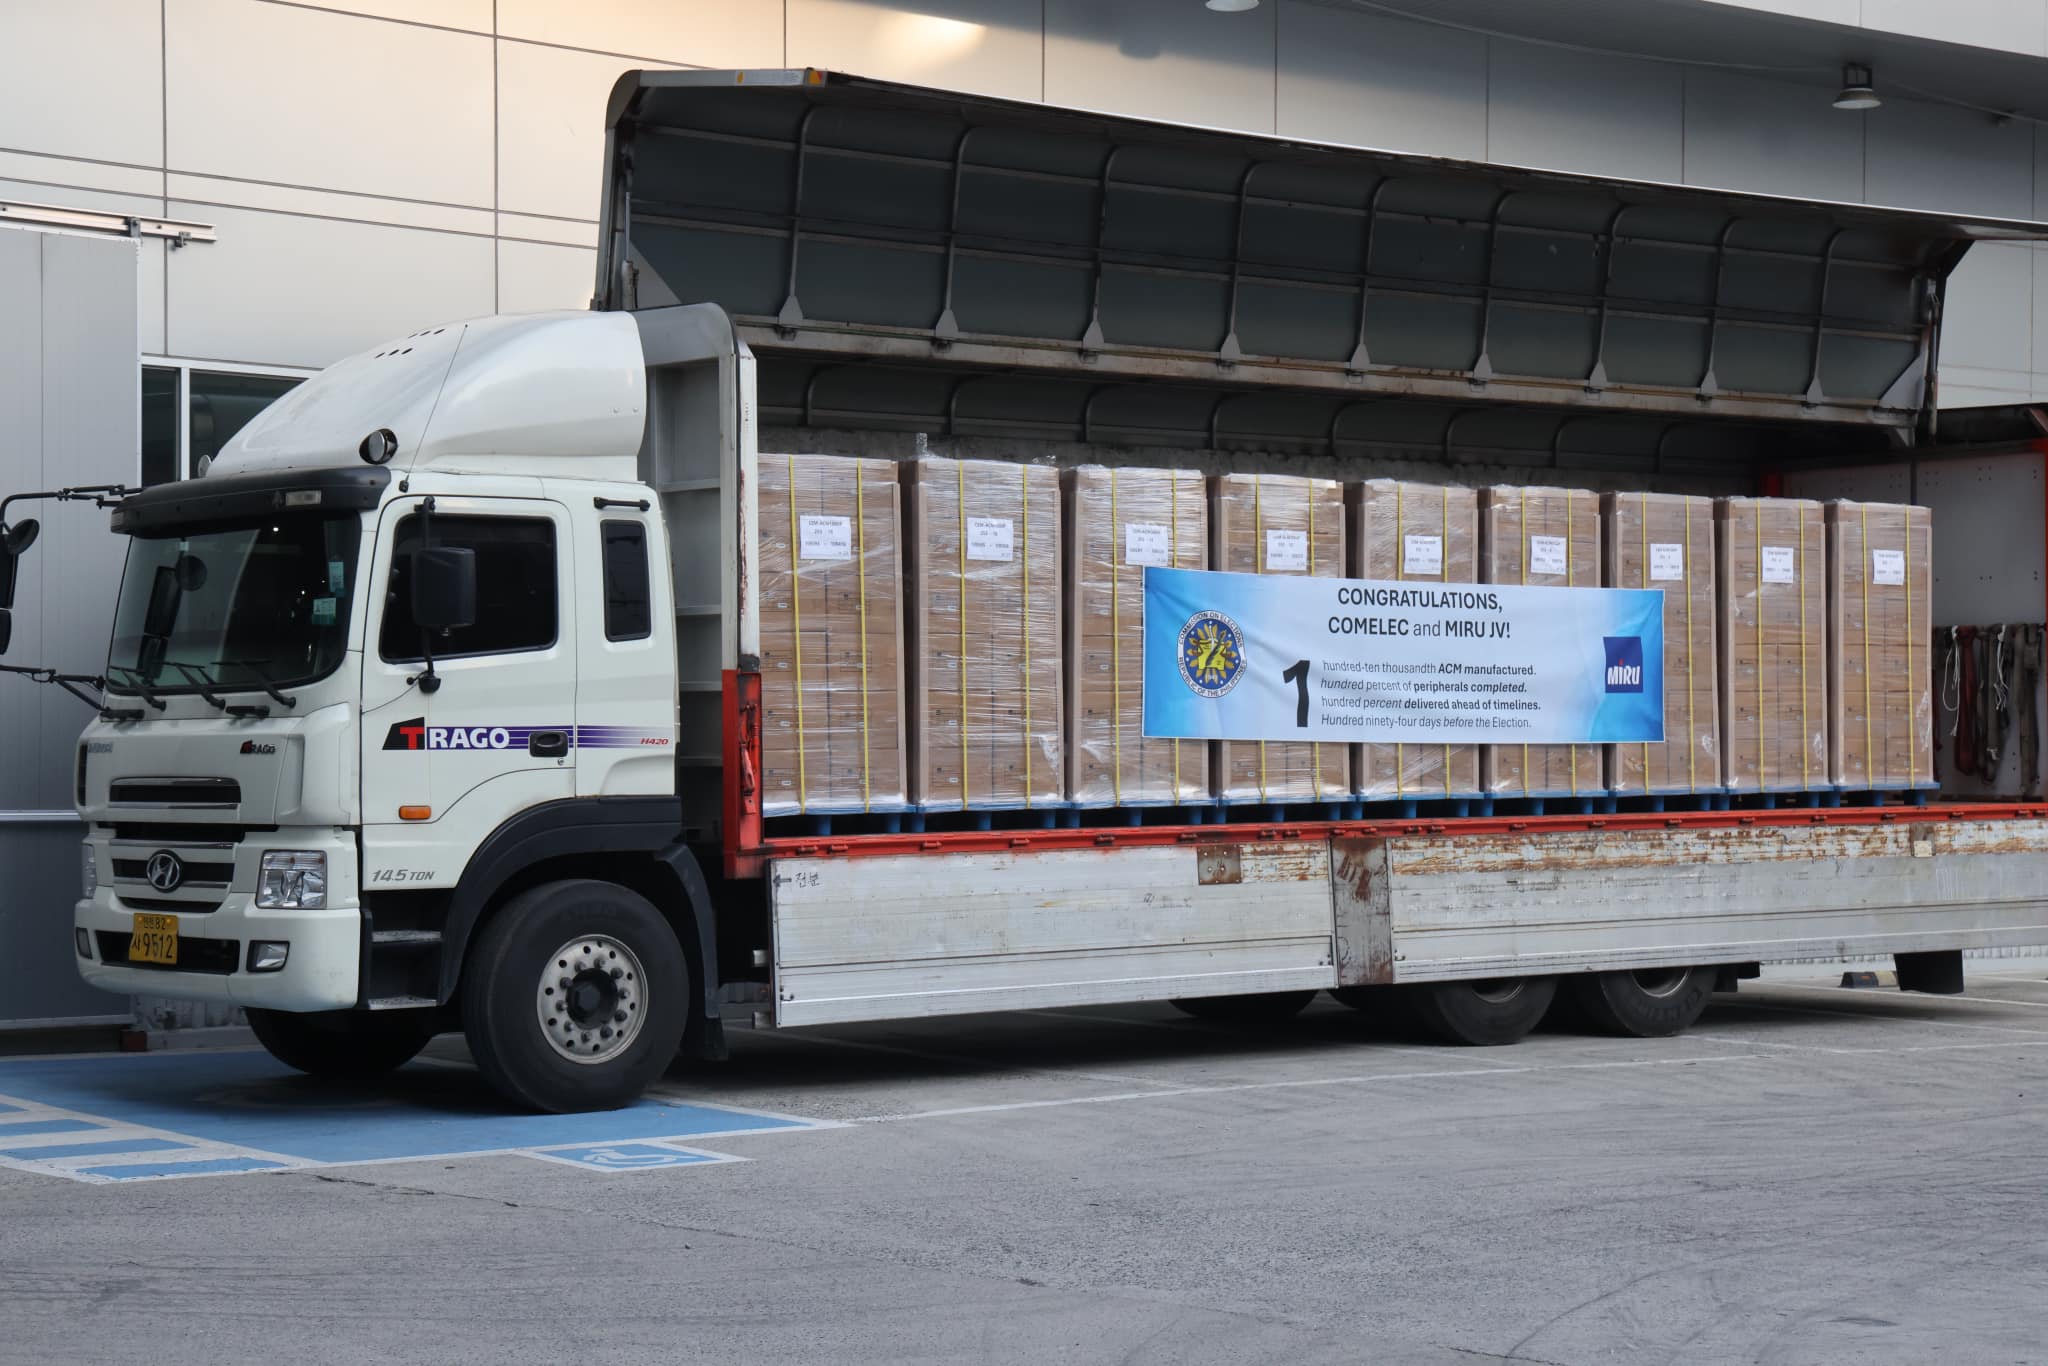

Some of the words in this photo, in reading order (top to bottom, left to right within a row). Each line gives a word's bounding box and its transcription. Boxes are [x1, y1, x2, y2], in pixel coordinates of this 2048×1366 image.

[1337, 587, 1503, 613] CONGRATULATIONS,
[1328, 616, 1409, 636] COMELEC
[1413, 620, 1441, 637] and
[1445, 620, 1485, 638] MIRU
[1489, 621, 1511, 639] JV!
[1323, 660, 1380, 674] hundred-ten
[1382, 661, 1436, 675] thousandth
[1438, 663, 1462, 675] ACM
[1464, 664, 1537, 676] manufactured.
[1282, 660, 1310, 728] 1
[1320, 678, 1364, 690] hundred
[1366, 681, 1401, 692] percent
[1402, 680, 1412, 691] of
[1414, 681, 1469, 694] peripherals
[1470, 682, 1527, 695] completed.
[1321, 696, 1362, 708] hundred
[1363, 699, 1402, 710] percent
[1404, 698, 1449, 709] delivered
[1451, 698, 1480, 710] ahead
[1482, 699, 1492, 710] of
[1493, 699, 1541, 711] timelines.
[1321, 714, 1364, 726] Hundred
[1366, 714, 1417, 729] ninety-four
[1418, 716, 1442, 729] days
[1443, 716, 1474, 728] before
[1475, 717, 1491, 728] the
[1492, 716, 1532, 728] Election.
[398, 726, 510, 749] TRAGO
[640, 737, 669, 746] H420
[372, 869, 409, 882] 14.5
[410, 871, 435, 881] TON
